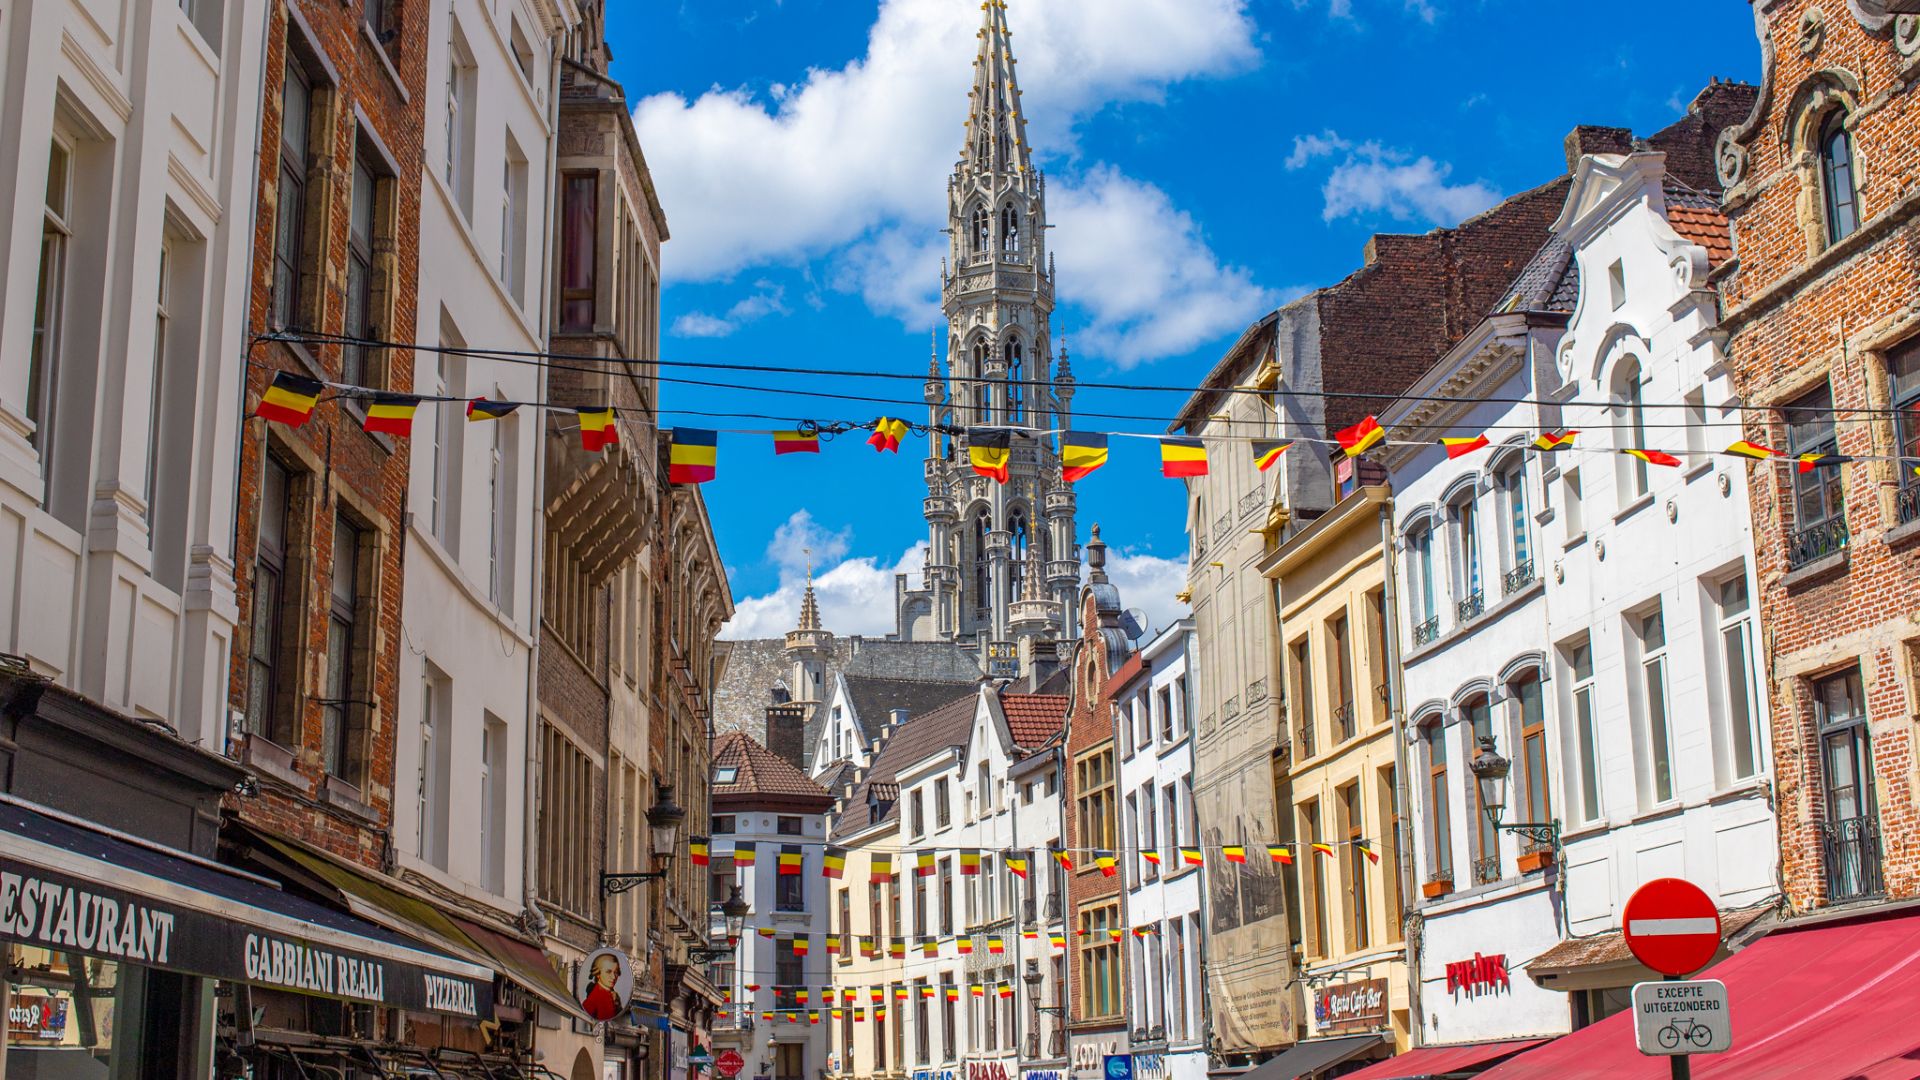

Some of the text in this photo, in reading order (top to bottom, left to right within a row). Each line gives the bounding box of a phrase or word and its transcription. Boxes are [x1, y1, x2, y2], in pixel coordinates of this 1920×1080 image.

[244, 933, 384, 1001] GABBIANI REALI
[423, 974, 478, 1016] PIZZERIA
[1366, 987, 1382, 1009] Bar
[1657, 986, 1704, 999] EXCEPTE
[1643, 1000, 1720, 1014] UITGEZONDERD
[969, 1061, 1008, 1080] PLAKA
